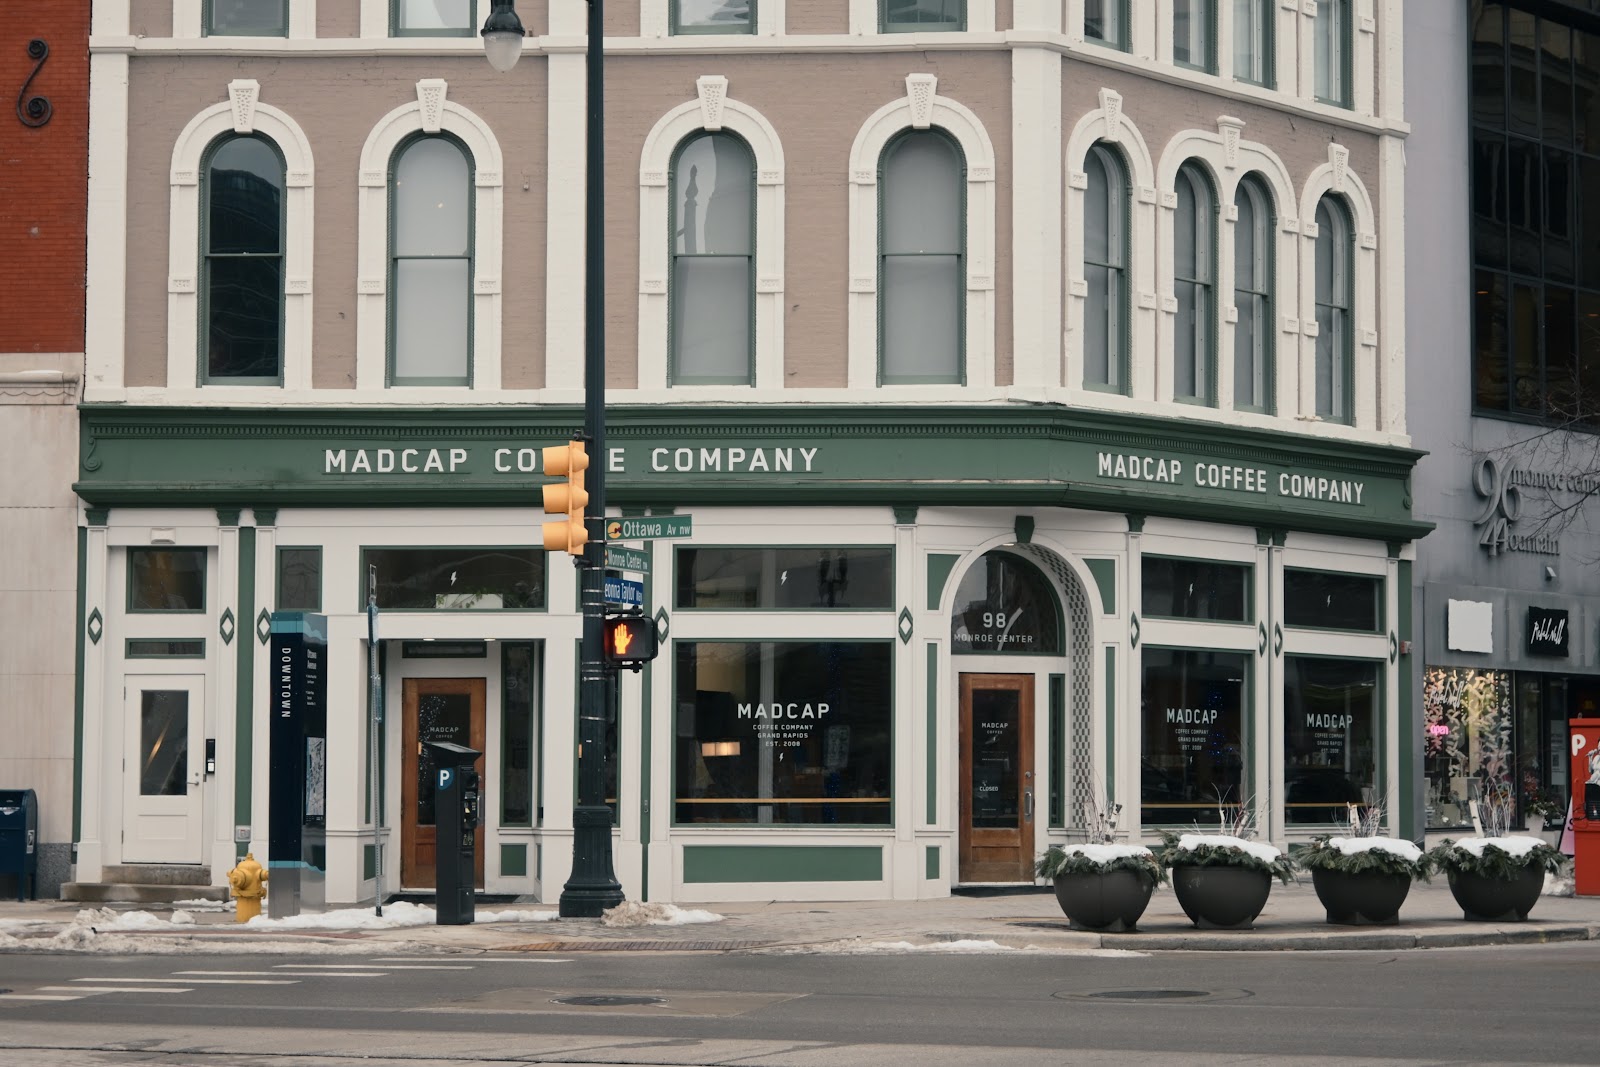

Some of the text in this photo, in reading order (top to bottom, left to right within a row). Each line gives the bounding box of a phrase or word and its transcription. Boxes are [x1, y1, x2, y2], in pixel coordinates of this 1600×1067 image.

[325, 447, 818, 473] MADCAP COE COMPANY
[1098, 452, 1364, 504] MADCAP COFFEE COMPANY
[1473, 455, 1521, 524] 96
[623, 521, 690, 537] Ottawa Av nw
[608, 550, 625, 567] Monroe
[626, 552, 642, 570] Center
[605, 583, 621, 598] eonna
[621, 582, 636, 604] Taylor
[983, 612, 1006, 628] 98
[953, 633, 1033, 643] MONROE CENTER
[282, 647, 291, 718] DOWNTOWN
[737, 703, 830, 719] MADCAP
[1166, 708, 1218, 724] MADCAP
[1306, 713, 1353, 728] MADCAP
[440, 769, 450, 786] P
